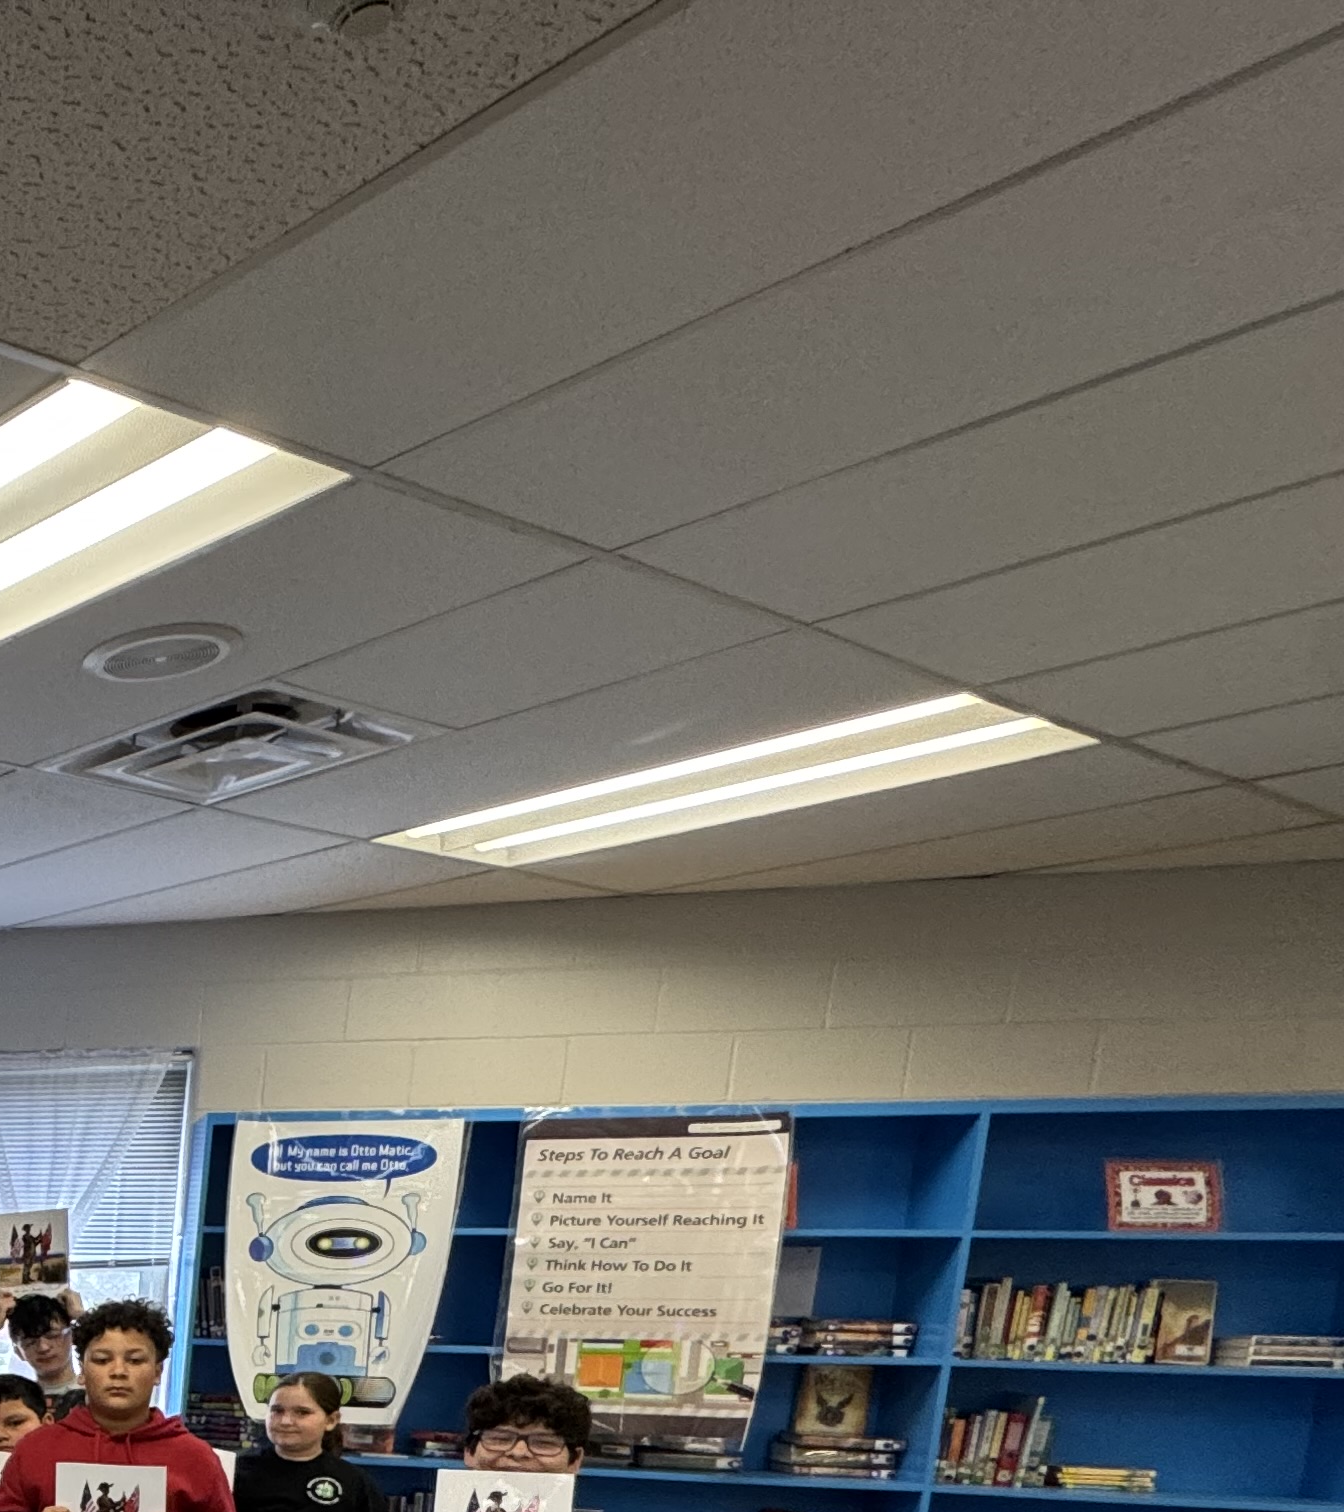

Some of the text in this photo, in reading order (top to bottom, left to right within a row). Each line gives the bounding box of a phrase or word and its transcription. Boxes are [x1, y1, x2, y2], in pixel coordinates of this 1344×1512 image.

[339, 1145, 348, 1157] is
[351, 1145, 376, 1157] Otto
[538, 1145, 731, 1164] Steps To Reach A Goal
[339, 1160, 359, 1172] call
[362, 1162, 377, 1172] me
[552, 1193, 612, 1204] Name It
[549, 1214, 765, 1229] Picture Yourself Reaching It
[548, 1237, 579, 1251] Say,
[545, 1260, 693, 1272] Think How To Do It
[542, 1282, 612, 1294] Go For It!
[540, 1304, 717, 1318] Celebrate Your Success
